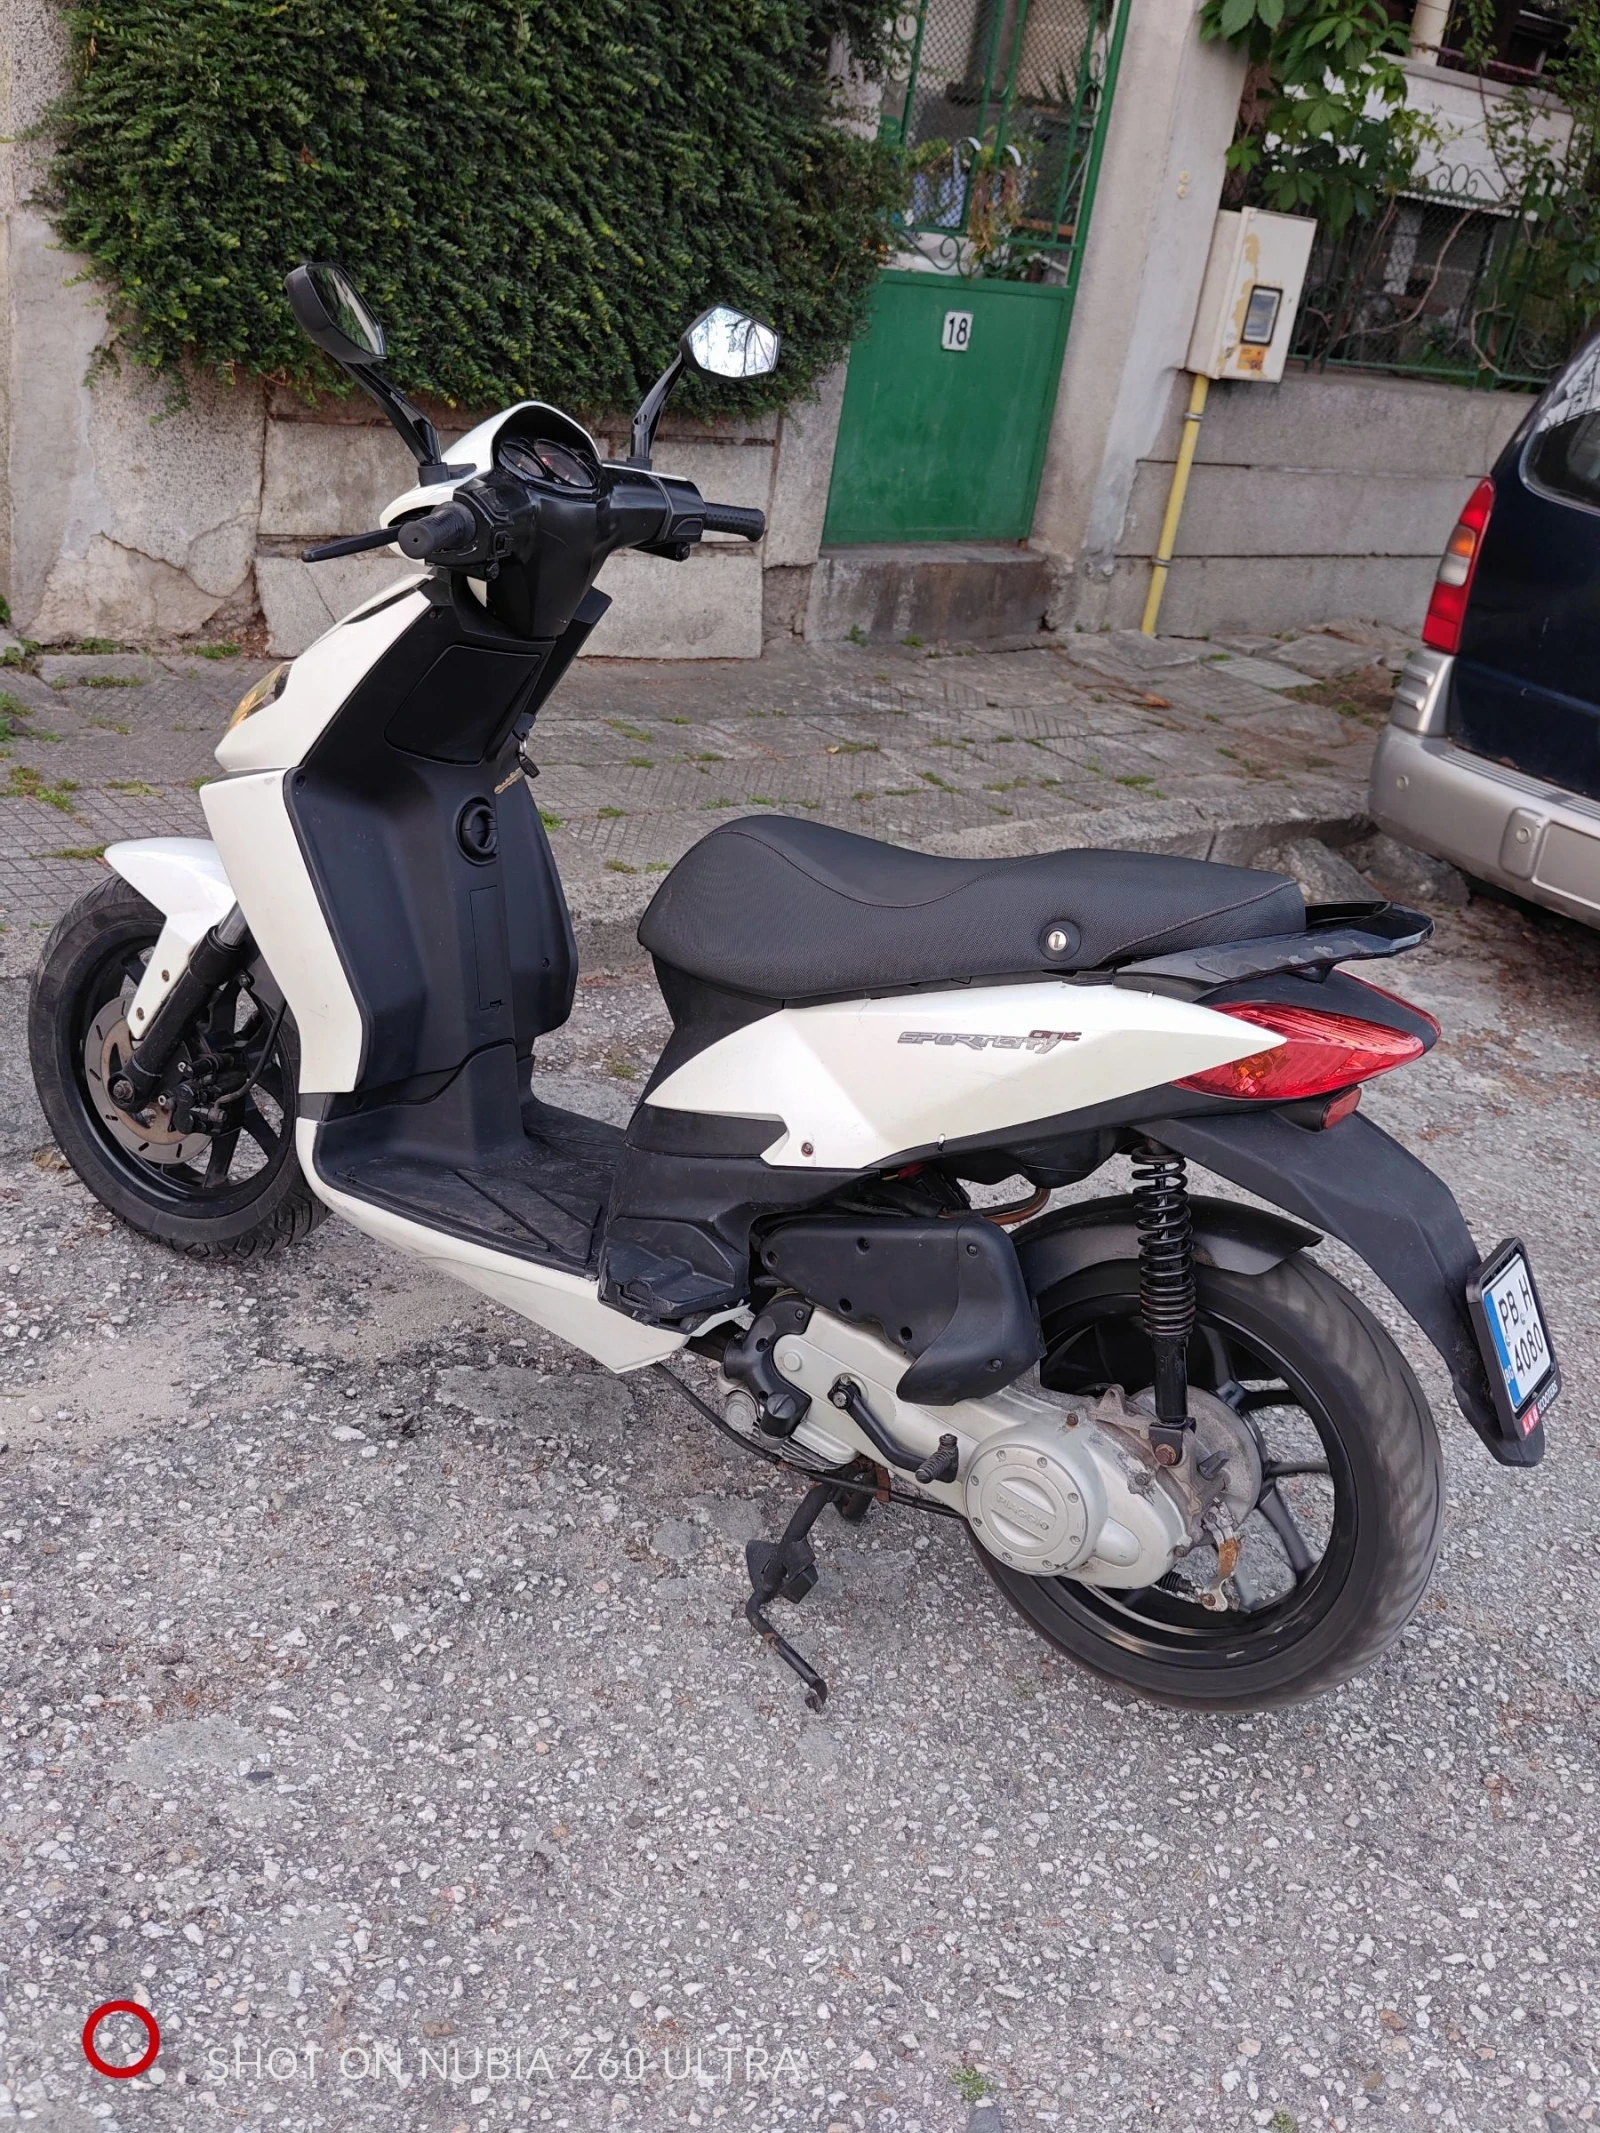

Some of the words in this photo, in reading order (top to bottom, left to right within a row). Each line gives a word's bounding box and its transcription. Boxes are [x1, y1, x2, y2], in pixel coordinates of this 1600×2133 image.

[949, 317, 968, 345] 18
[1498, 1290, 1519, 1334] PB
[1518, 1274, 1533, 1312] H
[1514, 1322, 1544, 1376] 4080
